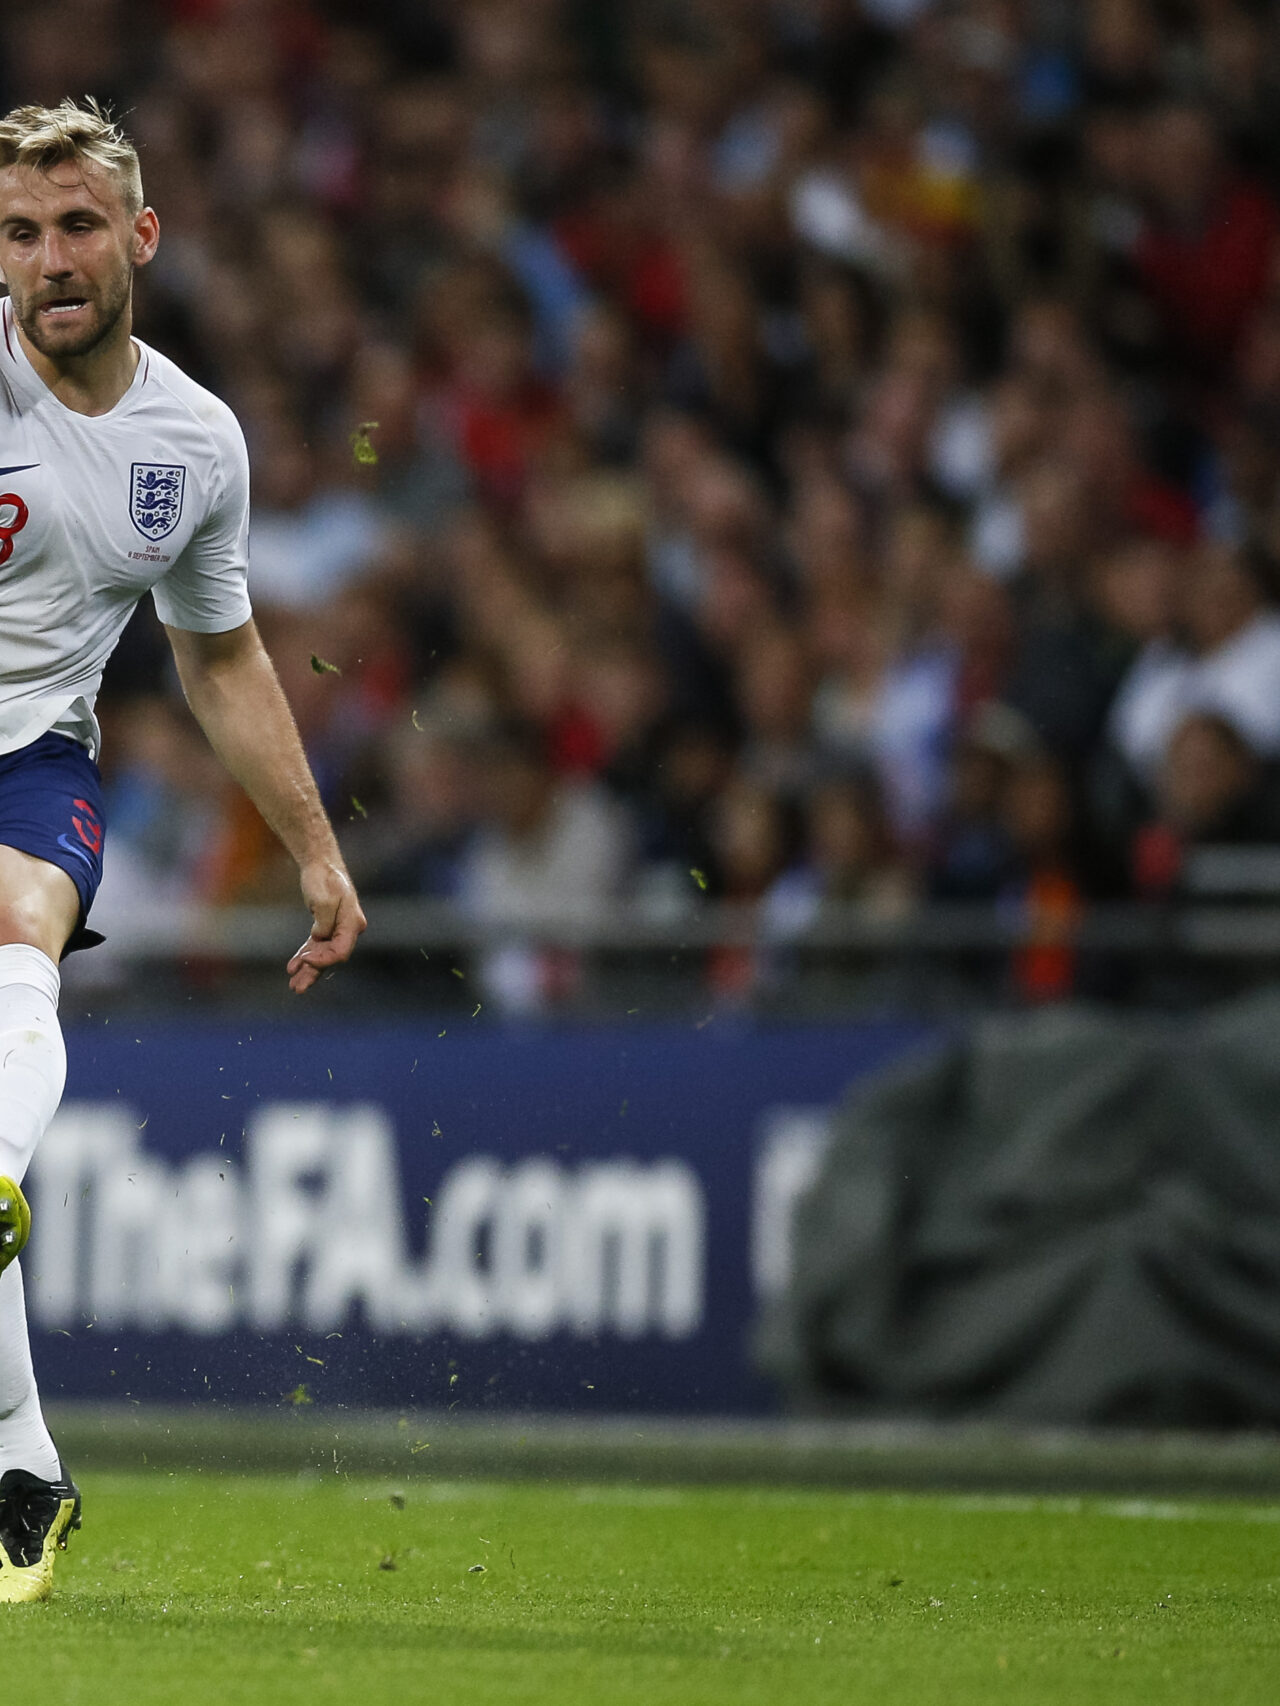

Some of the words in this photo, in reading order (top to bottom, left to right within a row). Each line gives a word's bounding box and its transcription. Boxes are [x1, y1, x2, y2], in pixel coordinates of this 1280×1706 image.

[133, 552, 160, 561] SEPTEMBER
[145, 545, 160, 553] SPAIN
[72, 799, 101, 854] 3
[28, 1102, 706, 1340] TheFA.com
